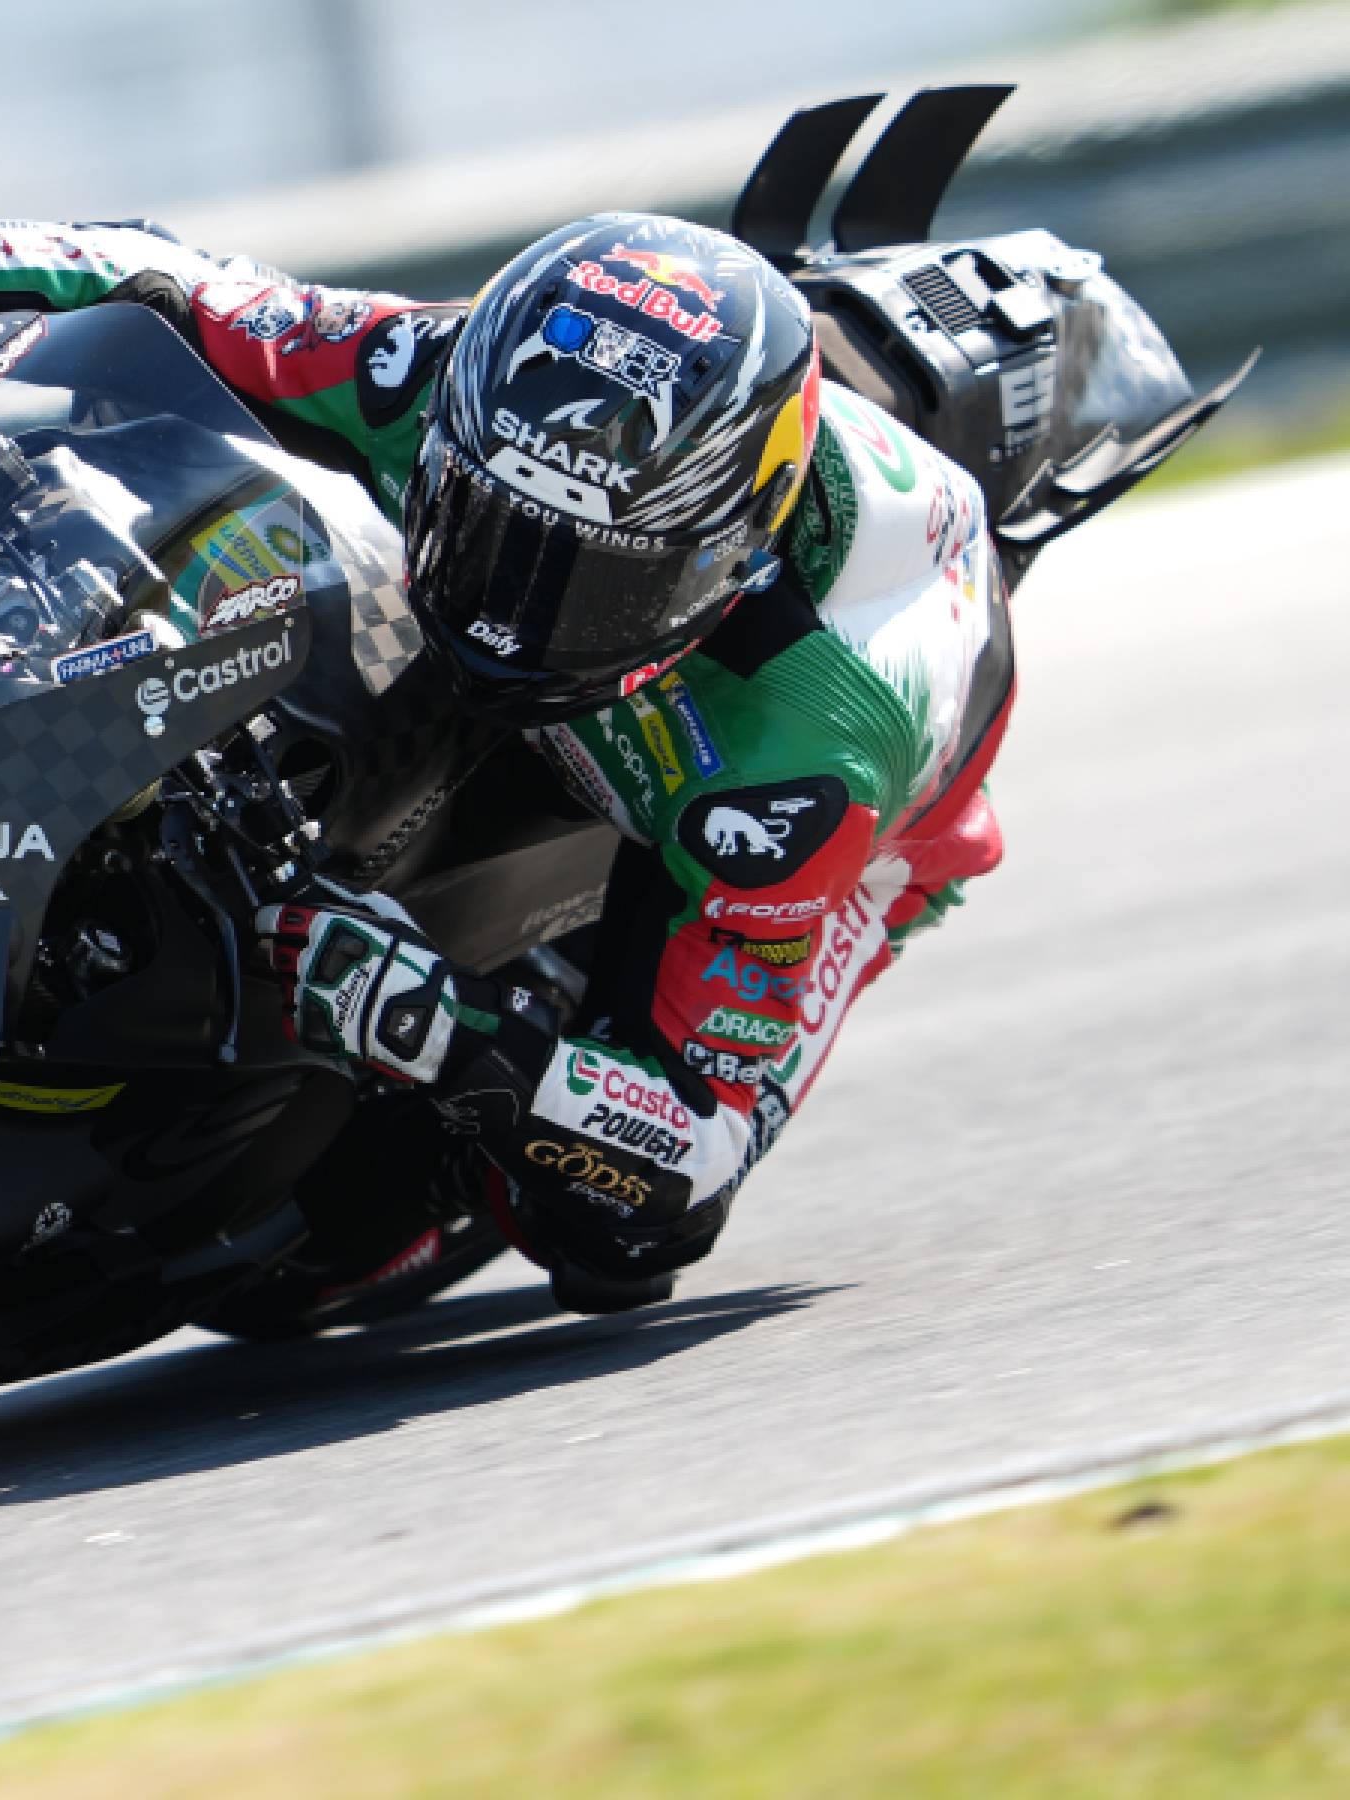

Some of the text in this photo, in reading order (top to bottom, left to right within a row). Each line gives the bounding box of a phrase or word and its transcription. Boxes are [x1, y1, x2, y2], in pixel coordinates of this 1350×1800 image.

[567, 261, 723, 342] Red Bull
[490, 407, 640, 494] SHARK
[508, 492, 560, 525] YOU
[575, 520, 667, 551] WINGS
[173, 629, 292, 702] Castrol
